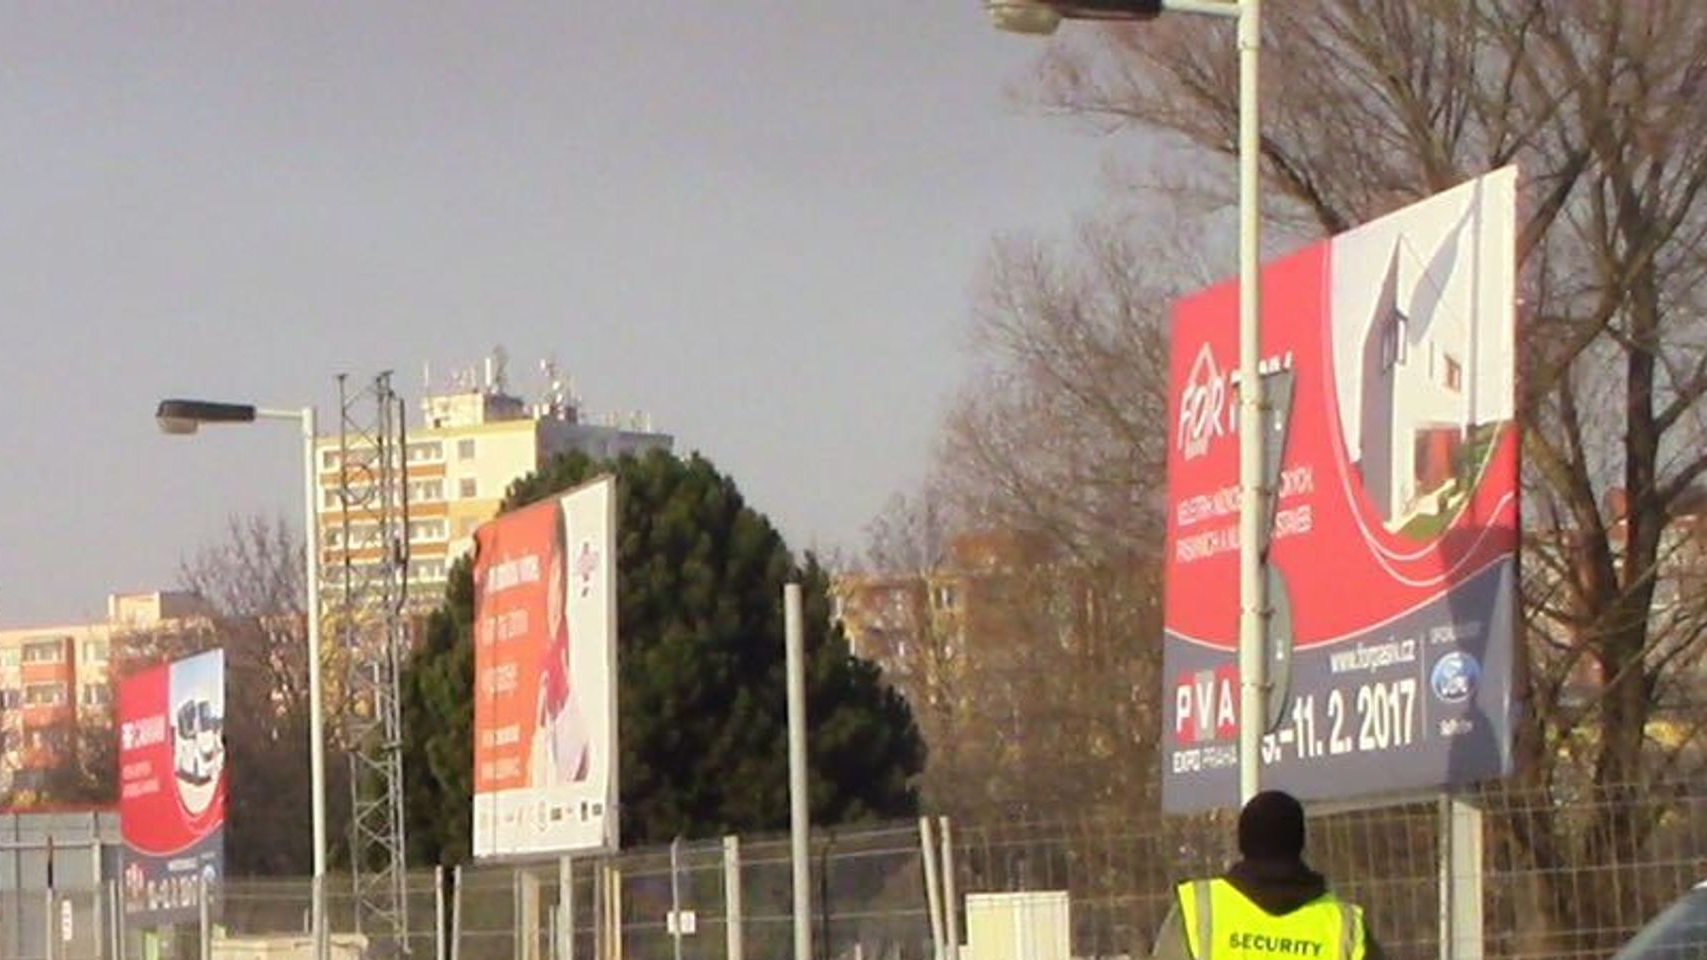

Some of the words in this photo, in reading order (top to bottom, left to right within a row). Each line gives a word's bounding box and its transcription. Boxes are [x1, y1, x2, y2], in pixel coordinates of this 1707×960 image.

[1175, 678, 1235, 734] PVA
[1327, 689, 1352, 755] 2.
[1358, 677, 1417, 751] 2017
[1230, 931, 1322, 956] SECURITY
